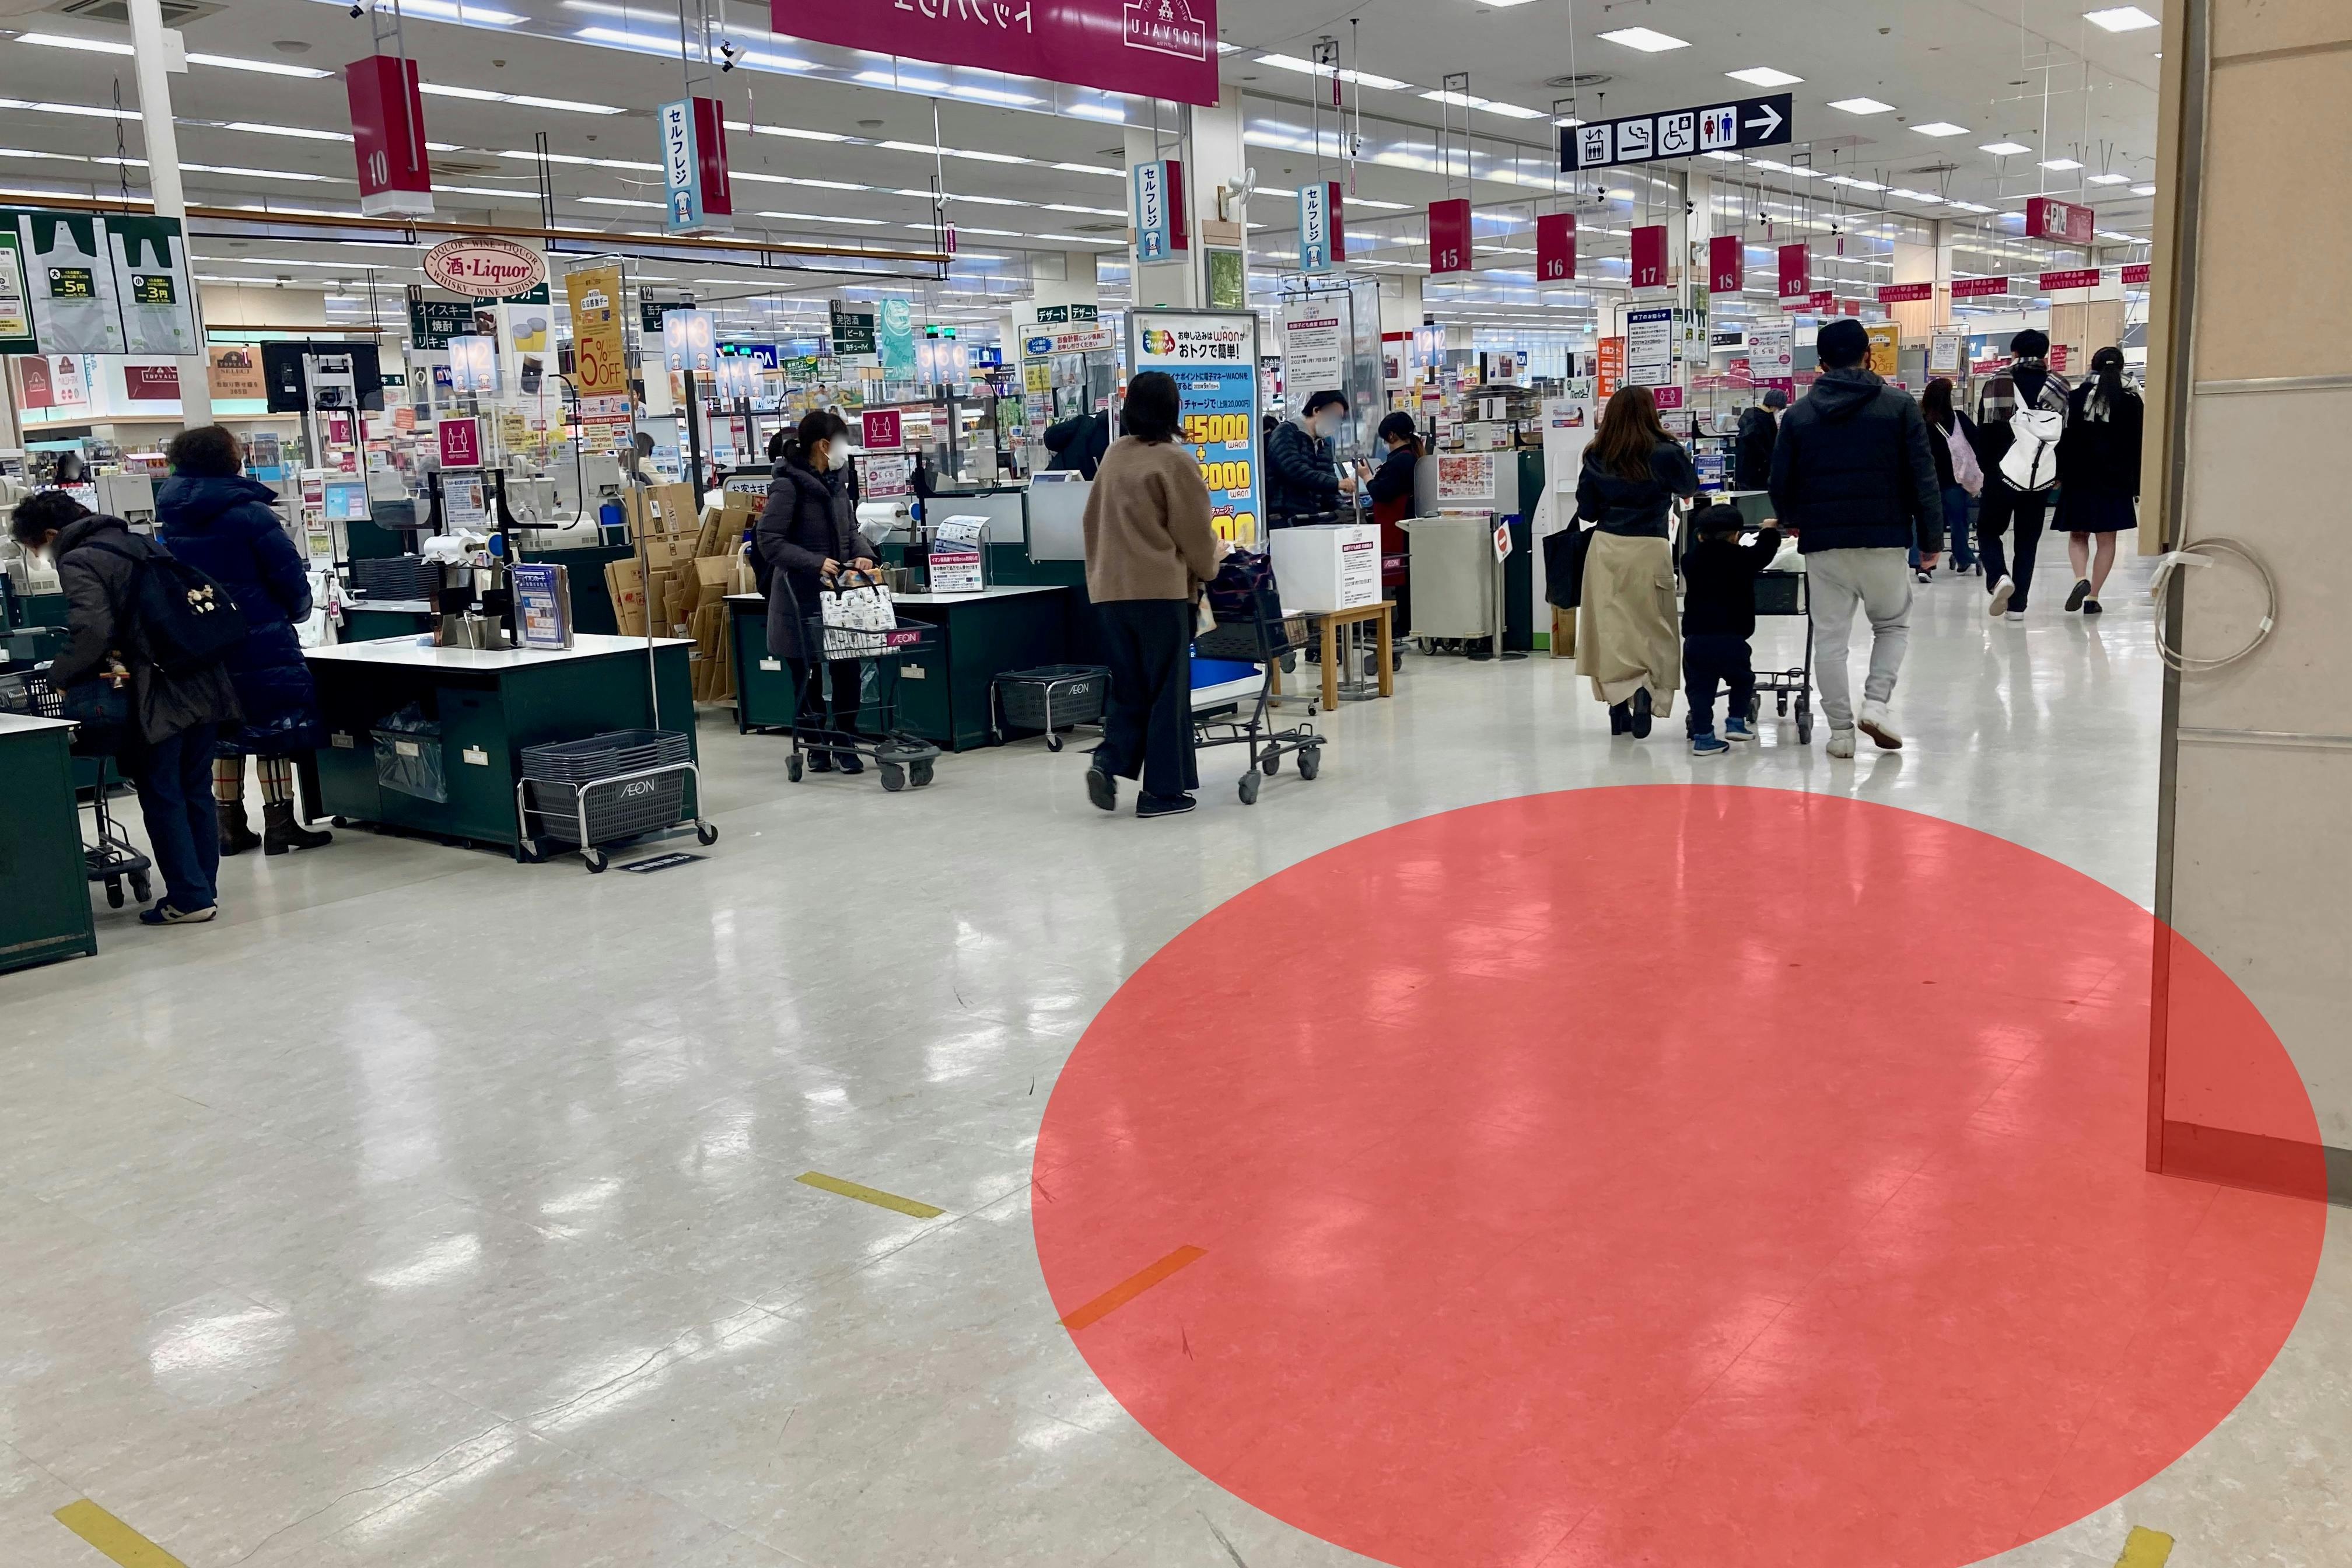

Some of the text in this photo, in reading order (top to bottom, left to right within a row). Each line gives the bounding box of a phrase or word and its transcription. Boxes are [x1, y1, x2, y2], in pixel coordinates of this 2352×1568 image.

[669, 110, 686, 185] セルフレジ
[368, 149, 387, 187] 10
[1144, 169, 1157, 227] セルフレジ
[1307, 189, 1319, 242] セルフレジ
[430, 240, 538, 265] LIQUOR WINE LIQUOR
[1440, 249, 1458, 268] 15
[1546, 258, 1563, 276] 16
[433, 270, 539, 296] WHISKY WINE WHISKY
[1640, 267, 1657, 284] 17
[1718, 274, 1734, 289] 18
[409, 285, 421, 301] 11
[642, 286, 653, 300] 12
[1787, 279, 1801, 294] 19
[417, 304, 469, 317] ウイスキー
[832, 300, 841, 313] 13
[1072, 306, 1097, 318] デザート
[836, 314, 860, 326] 発泡酒
[1038, 308, 1067, 322] デザート
[432, 321, 453, 333] 焼酎
[668, 317, 681, 348] 3
[846, 329, 865, 338] ビール
[598, 362, 621, 385] OFF
[1877, 363, 1894, 372] OFF
[1194, 414, 1250, 443] 5000
[1230, 489, 1249, 498] WAON
